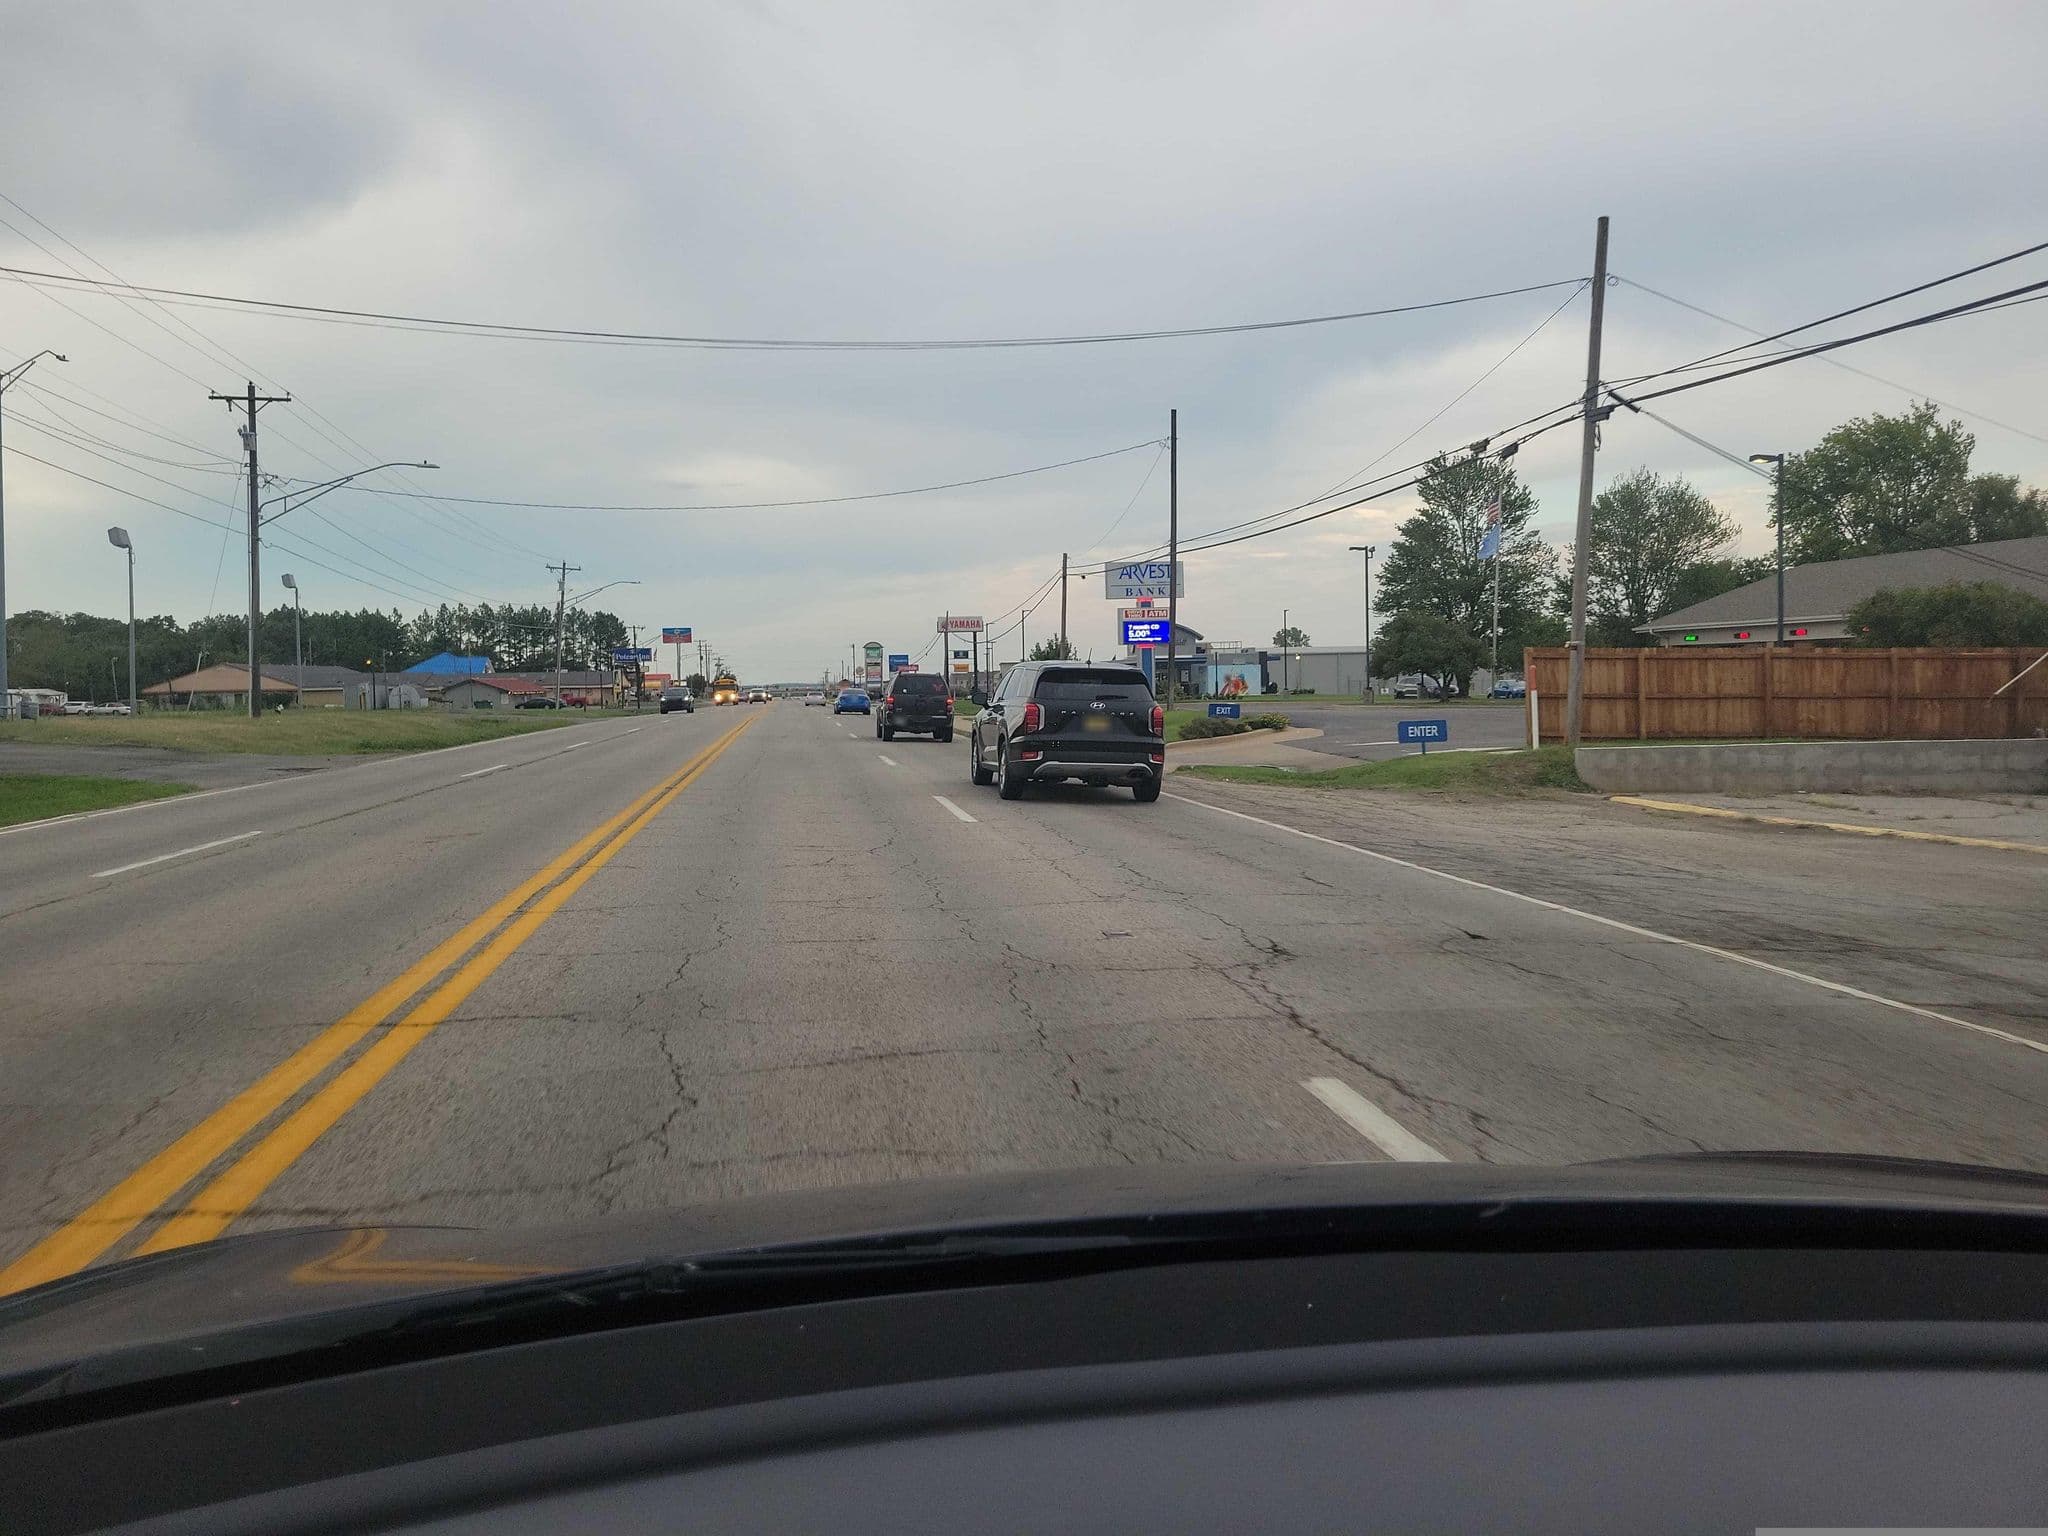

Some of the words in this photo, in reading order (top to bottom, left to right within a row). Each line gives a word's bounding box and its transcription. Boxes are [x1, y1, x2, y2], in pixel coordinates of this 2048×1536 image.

[1119, 564, 1171, 584] ARVEST
[1126, 587, 1165, 597] BANK
[950, 620, 981, 628] YAMAHA
[1216, 706, 1231, 715] EXIT
[1408, 725, 1438, 737] ENTER
